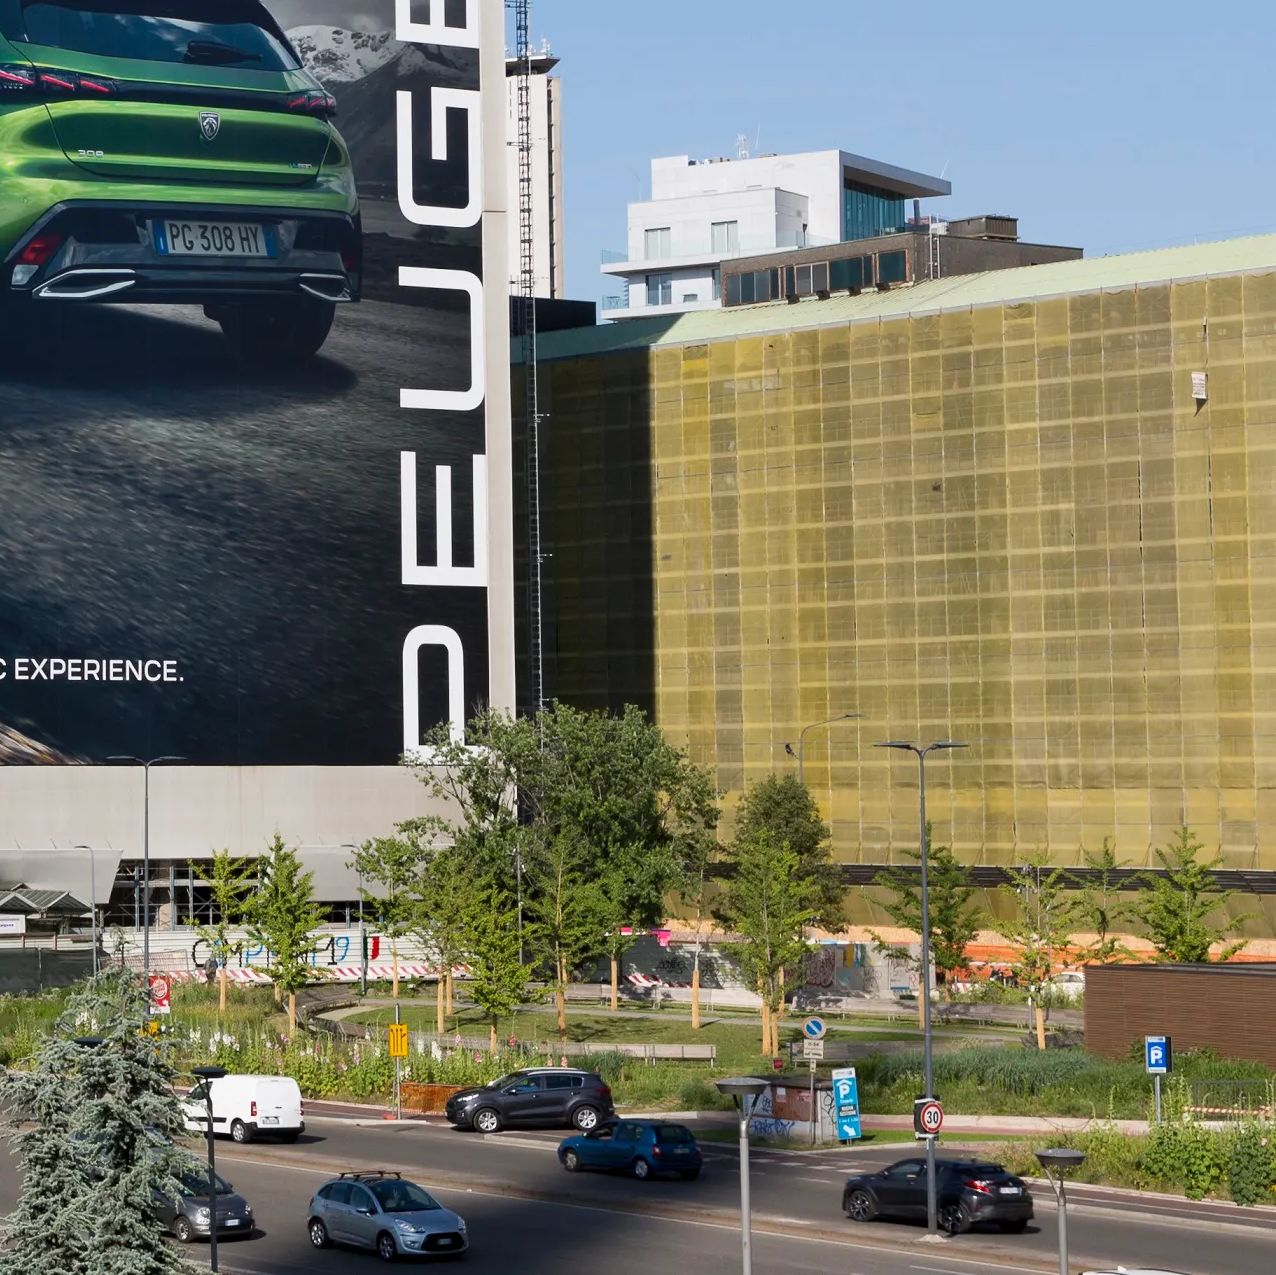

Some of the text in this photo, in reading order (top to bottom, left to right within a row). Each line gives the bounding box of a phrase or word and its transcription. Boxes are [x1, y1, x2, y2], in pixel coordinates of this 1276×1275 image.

[169, 223, 194, 251] PG
[198, 225, 236, 252] 308
[238, 226, 260, 253] HY
[15, 659, 185, 682] EXPERIENCE.
[926, 1111, 939, 1124] 30
